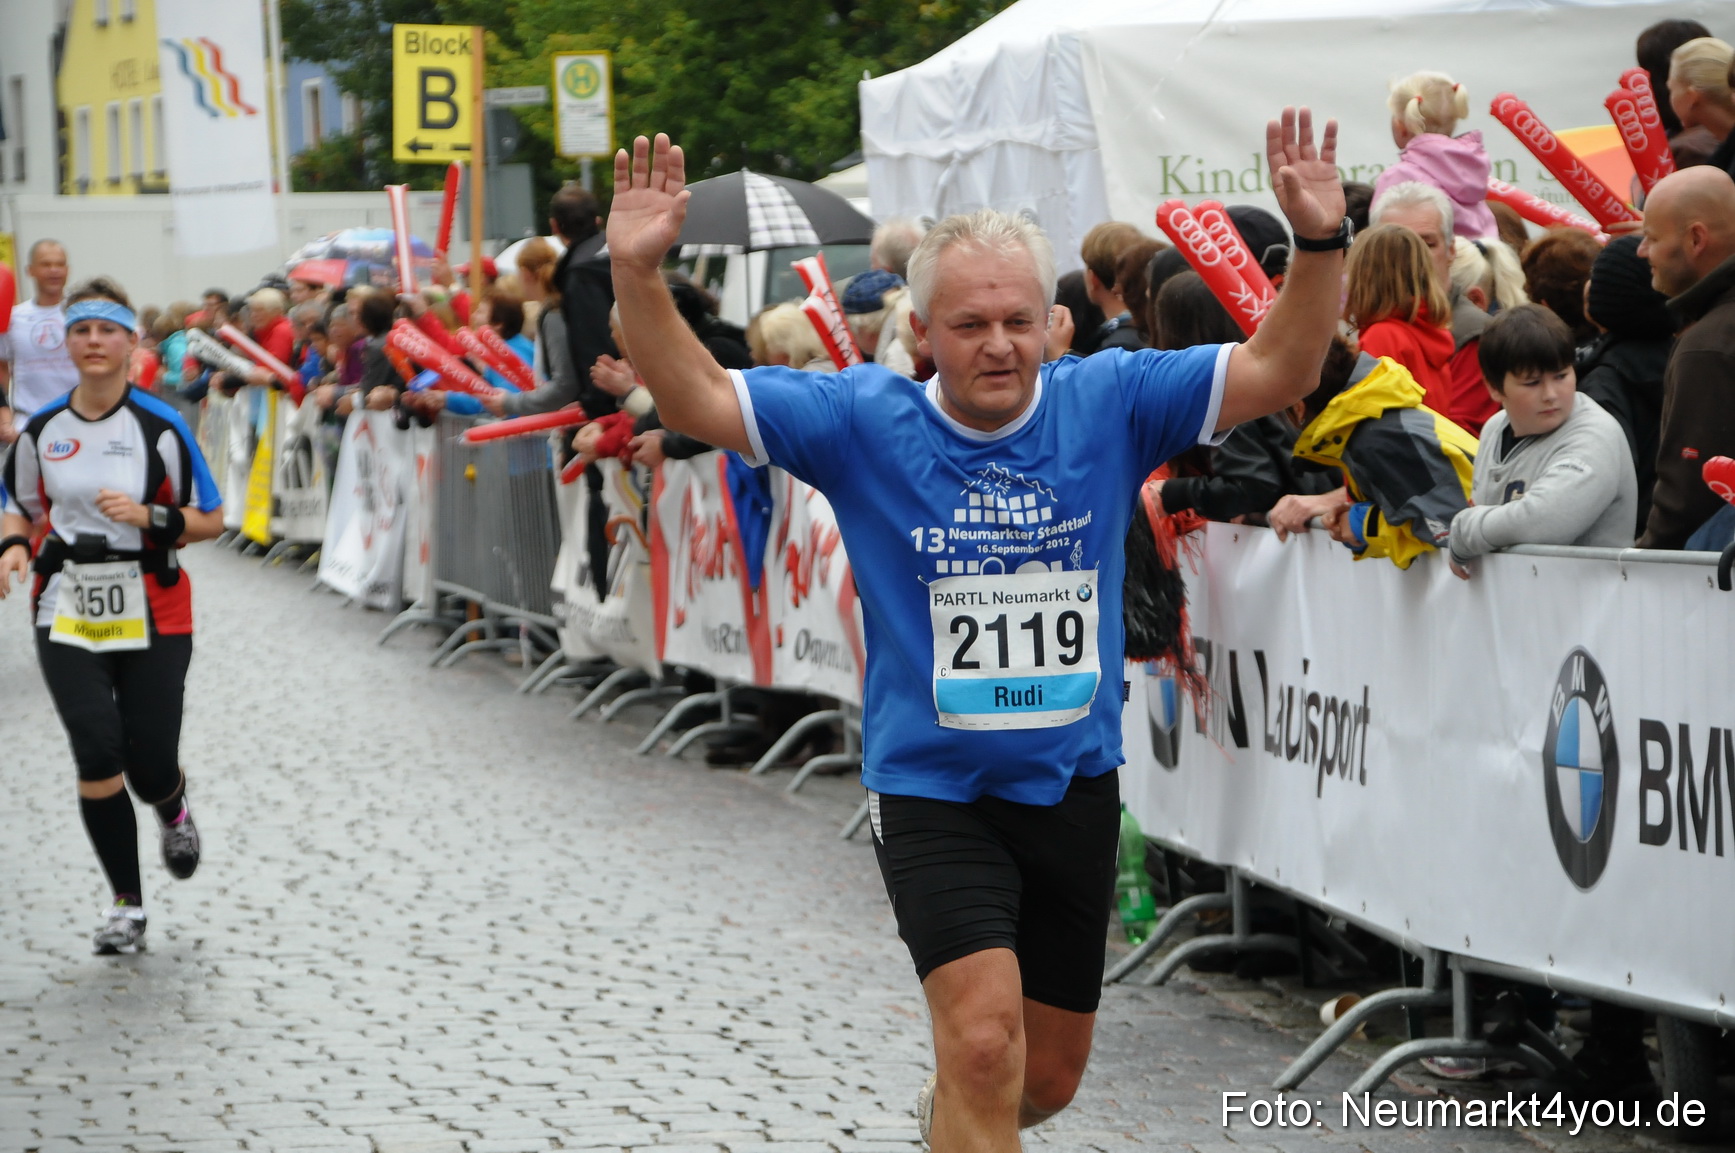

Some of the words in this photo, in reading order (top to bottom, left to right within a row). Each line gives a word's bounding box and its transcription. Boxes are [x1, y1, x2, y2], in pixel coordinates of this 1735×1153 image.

[404, 30, 473, 55] Block
[418, 66, 460, 129] B
[47, 440, 71, 454] tkn
[910, 526, 956, 554] 13.
[948, 527, 1034, 541] Neumarkter
[1037, 510, 1092, 540] Stadtlauf
[976, 543, 1043, 555] 16.September
[1046, 537, 1070, 549] 2012
[74, 584, 125, 617] 350
[933, 592, 989, 607] PARTL
[992, 588, 1071, 605] Neumarkt
[950, 610, 1084, 670] 2119
[939, 666, 948, 678] C
[994, 683, 1044, 708] Rudi
[1552, 655, 1613, 735] BMW
